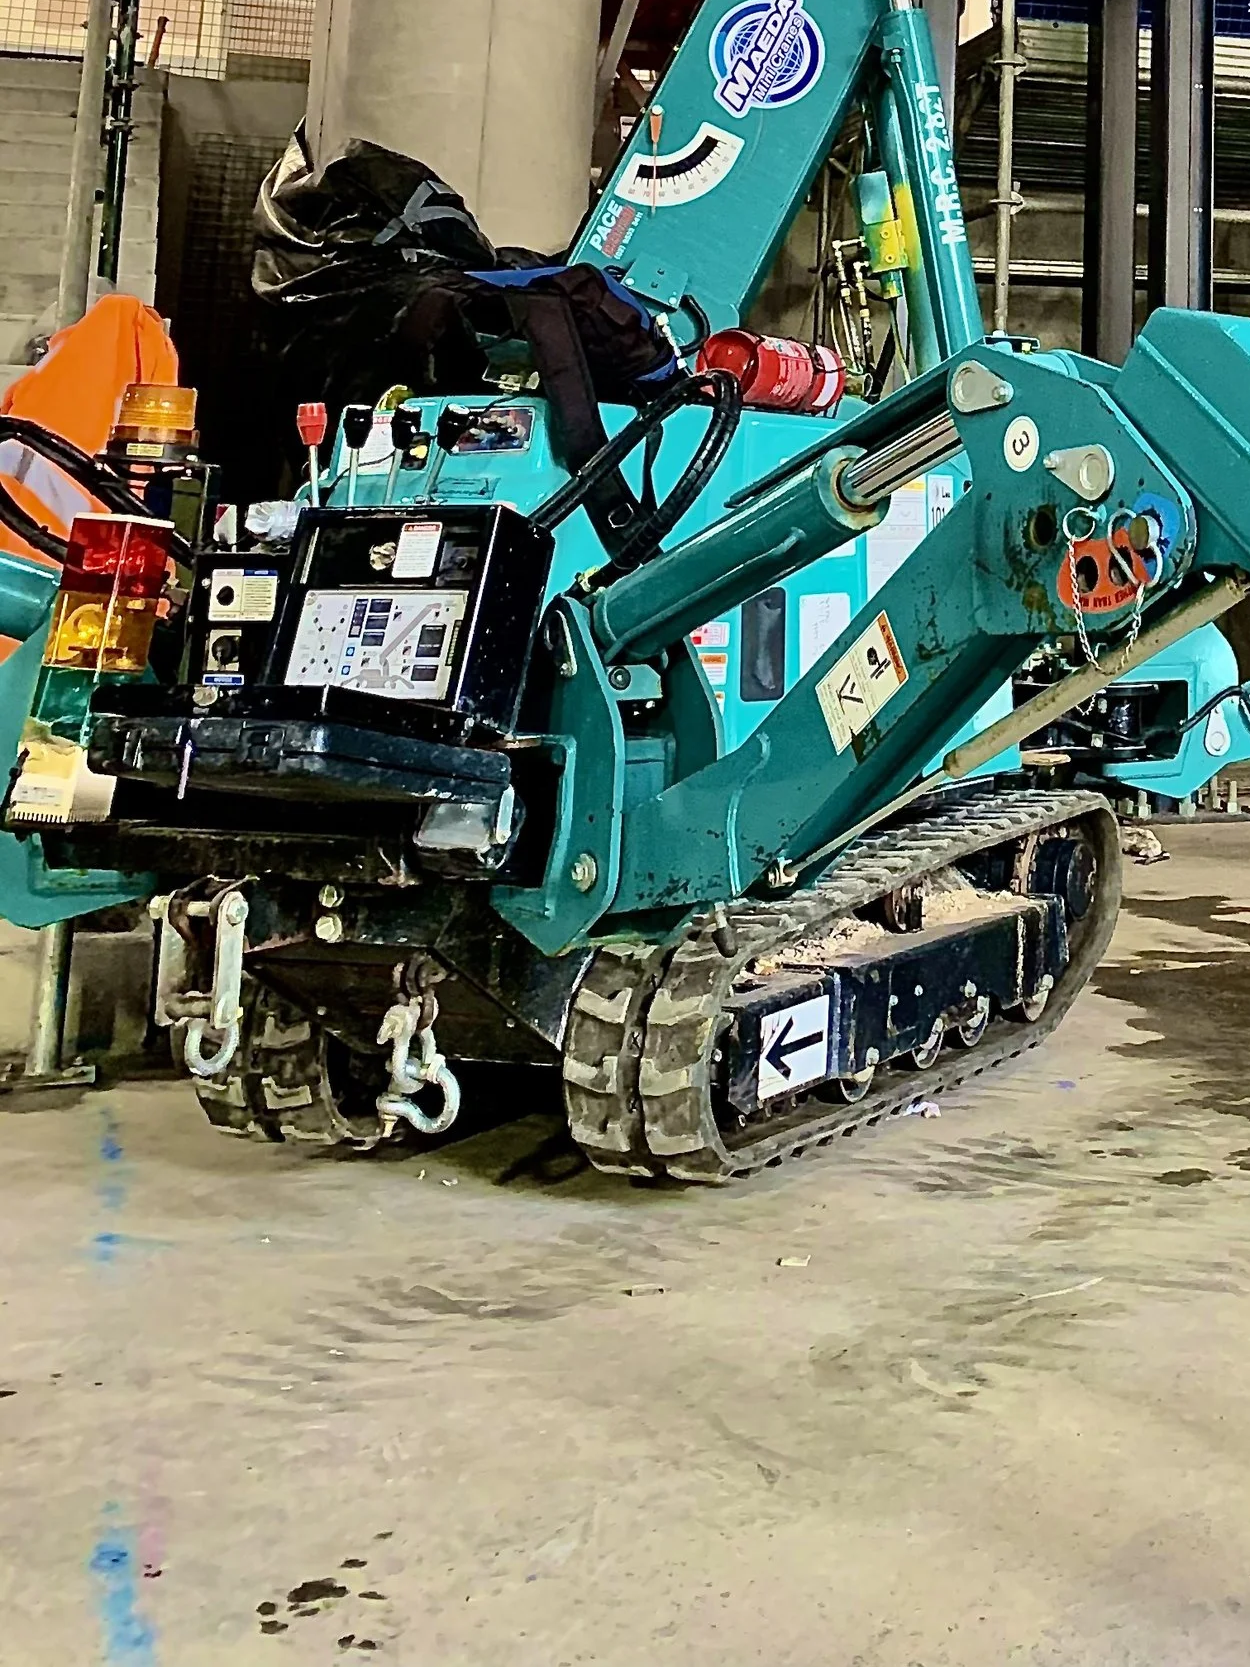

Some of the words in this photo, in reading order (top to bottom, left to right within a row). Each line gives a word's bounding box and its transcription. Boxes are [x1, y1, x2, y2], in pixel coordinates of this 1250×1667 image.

[752, 66, 777, 102] Mini
[769, 16, 804, 69] Cranes
[589, 199, 623, 251] PACE
[1013, 430, 1030, 456] 3
